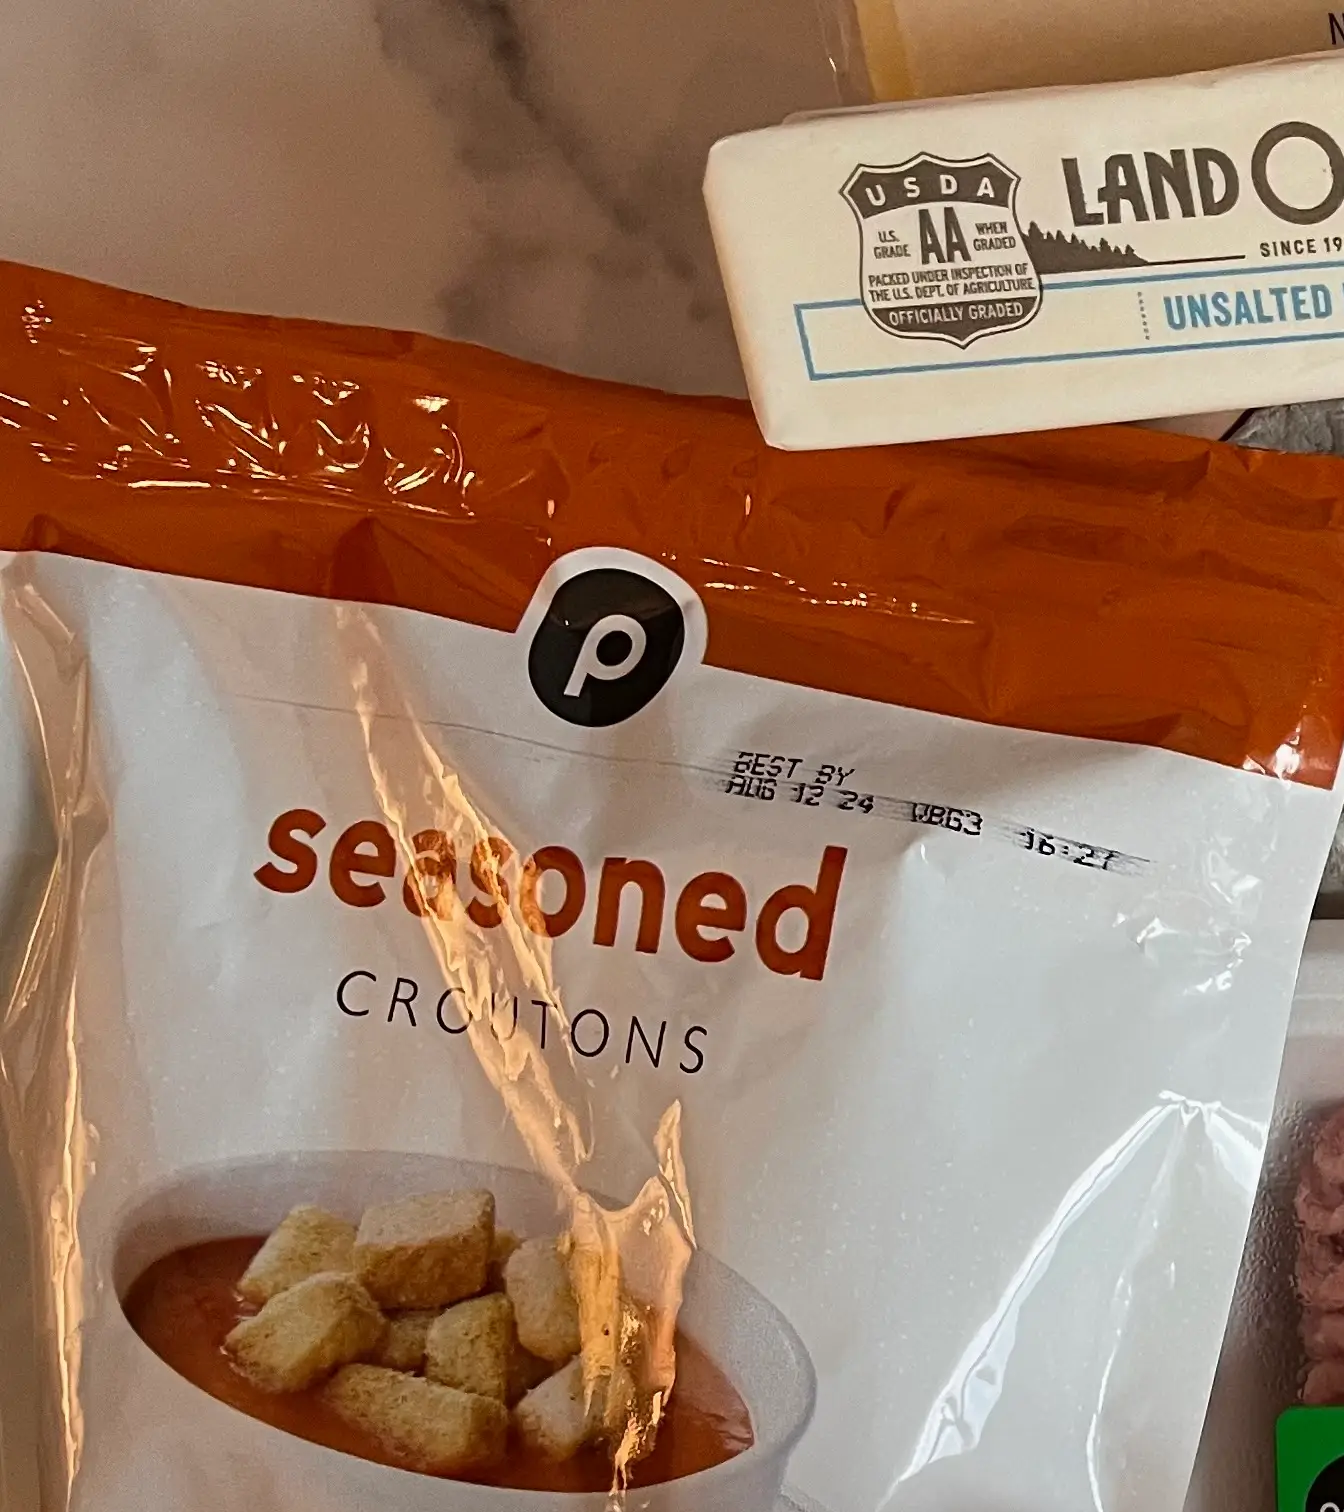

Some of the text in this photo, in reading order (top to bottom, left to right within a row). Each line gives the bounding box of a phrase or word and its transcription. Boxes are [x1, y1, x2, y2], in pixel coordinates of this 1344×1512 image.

[866, 174, 995, 206] USDA
[1061, 148, 1239, 227] LAND
[918, 206, 971, 265] AA
[975, 221, 1008, 235] WHEN
[874, 244, 911, 259] GRADE
[973, 236, 1016, 251] GRADED
[1259, 238, 1317, 258] SINCE
[868, 266, 1012, 287] PACKED UNDER INSPECTION
[963, 278, 1035, 295] AGRICULTURE
[889, 302, 1023, 326] OFFICIALLY GRADED
[1163, 283, 1332, 331] UNSALTED
[733, 751, 855, 786] BEST BY
[253, 808, 848, 981] seasoned
[336, 969, 709, 1075] CROUTONS
